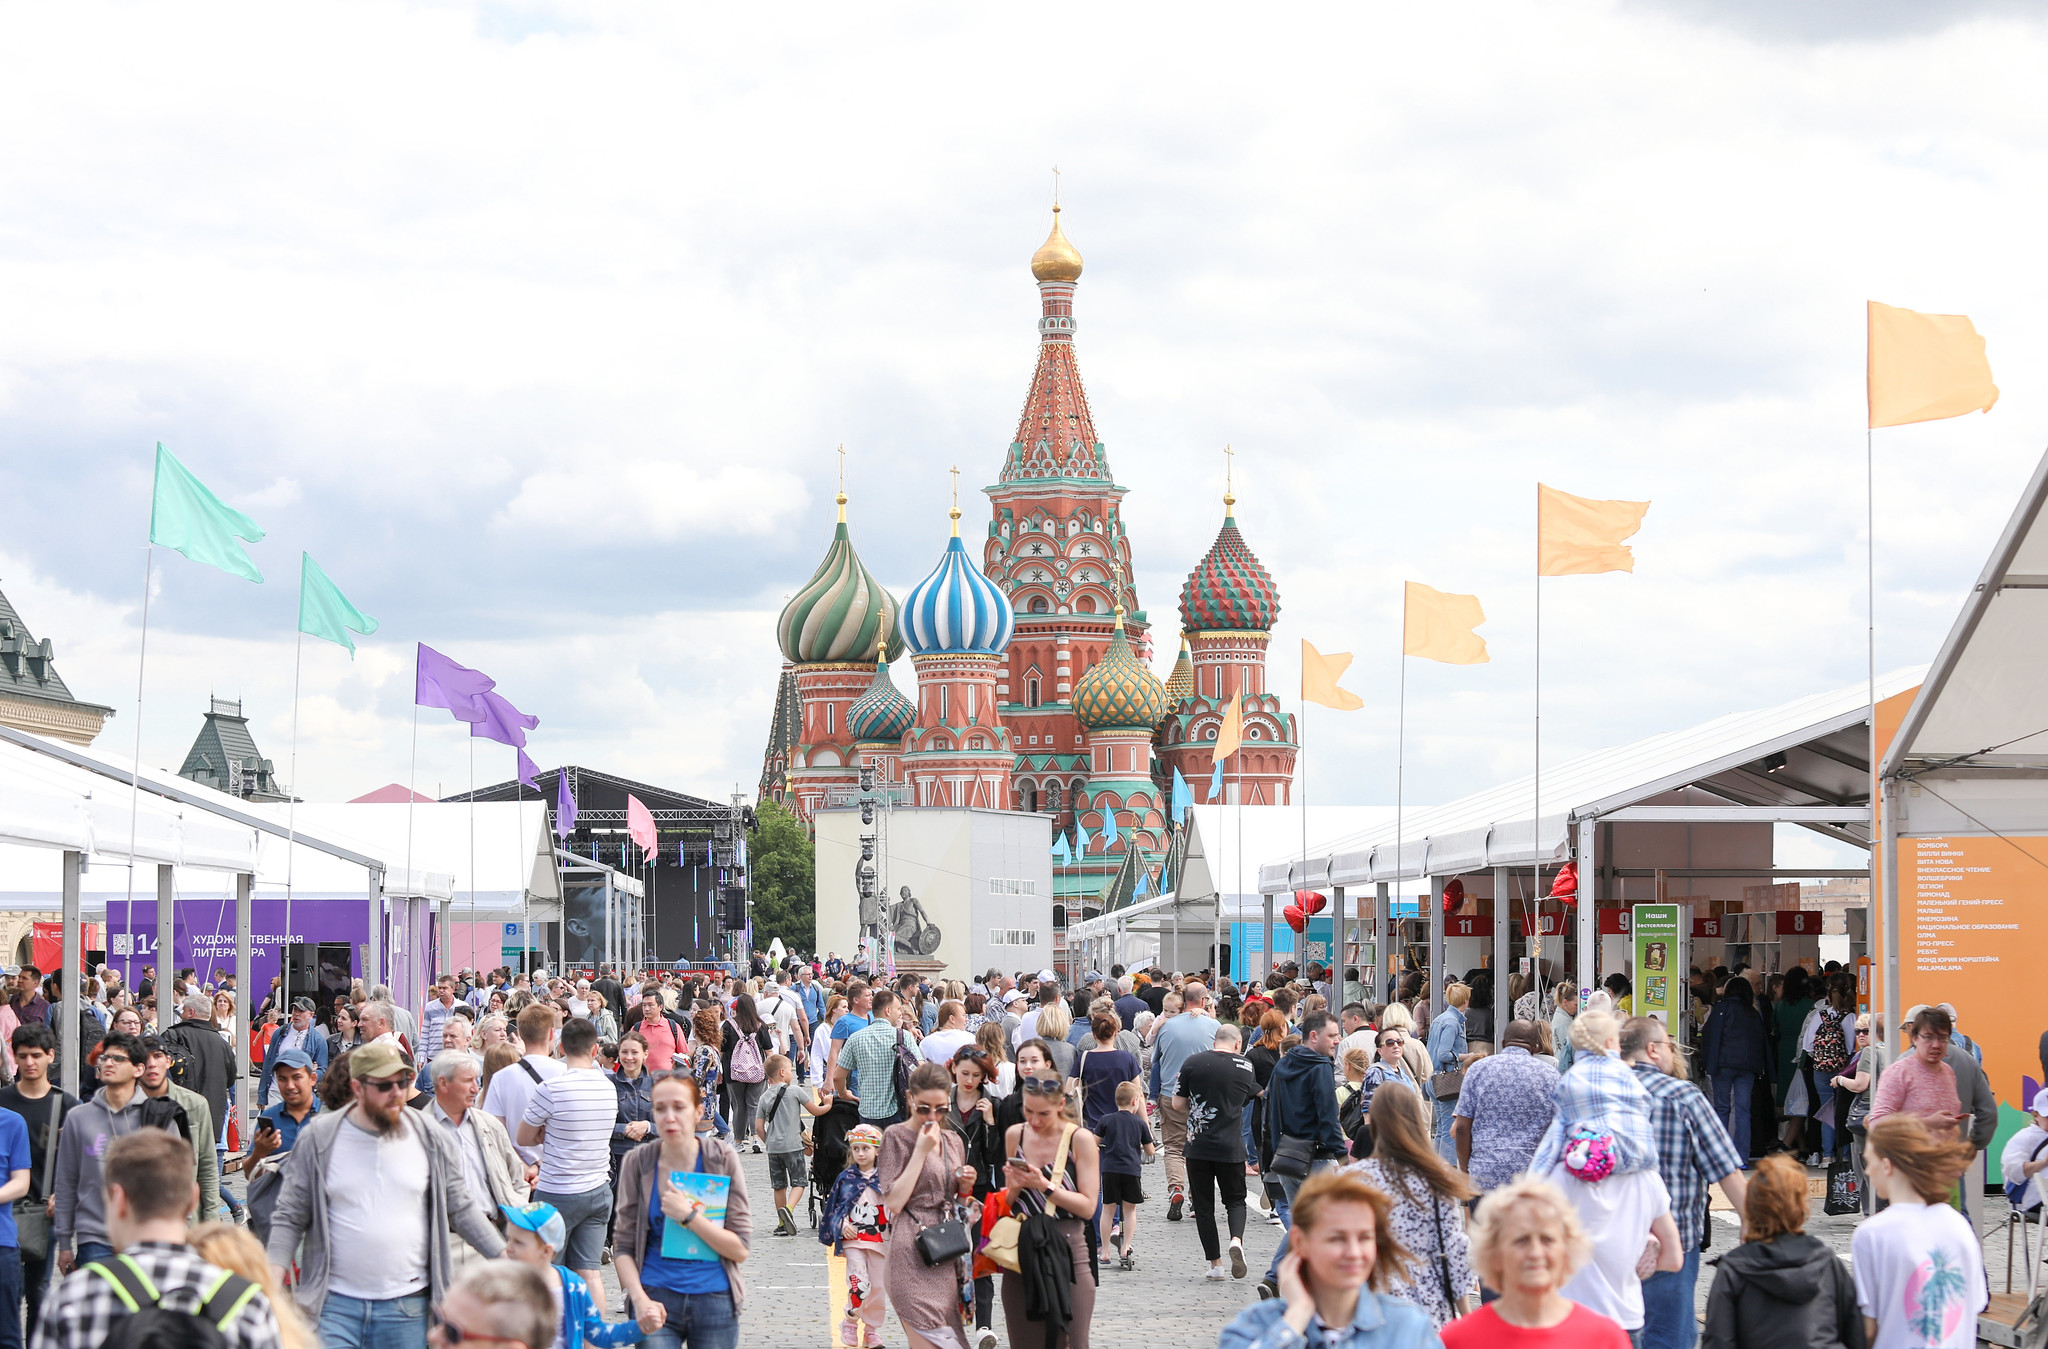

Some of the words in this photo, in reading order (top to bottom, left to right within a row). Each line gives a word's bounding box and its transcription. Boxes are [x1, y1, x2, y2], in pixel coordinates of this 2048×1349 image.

[1458, 919, 1473, 934] 11
[1539, 915, 1554, 932] 10
[1618, 912, 1630, 931] 9
[1703, 921, 1718, 935] 15
[1794, 914, 1805, 932] 8
[192, 934, 304, 946] ХУДОЖТВЕННАЯ
[192, 948, 266, 957] ЛИТЕРАРА
